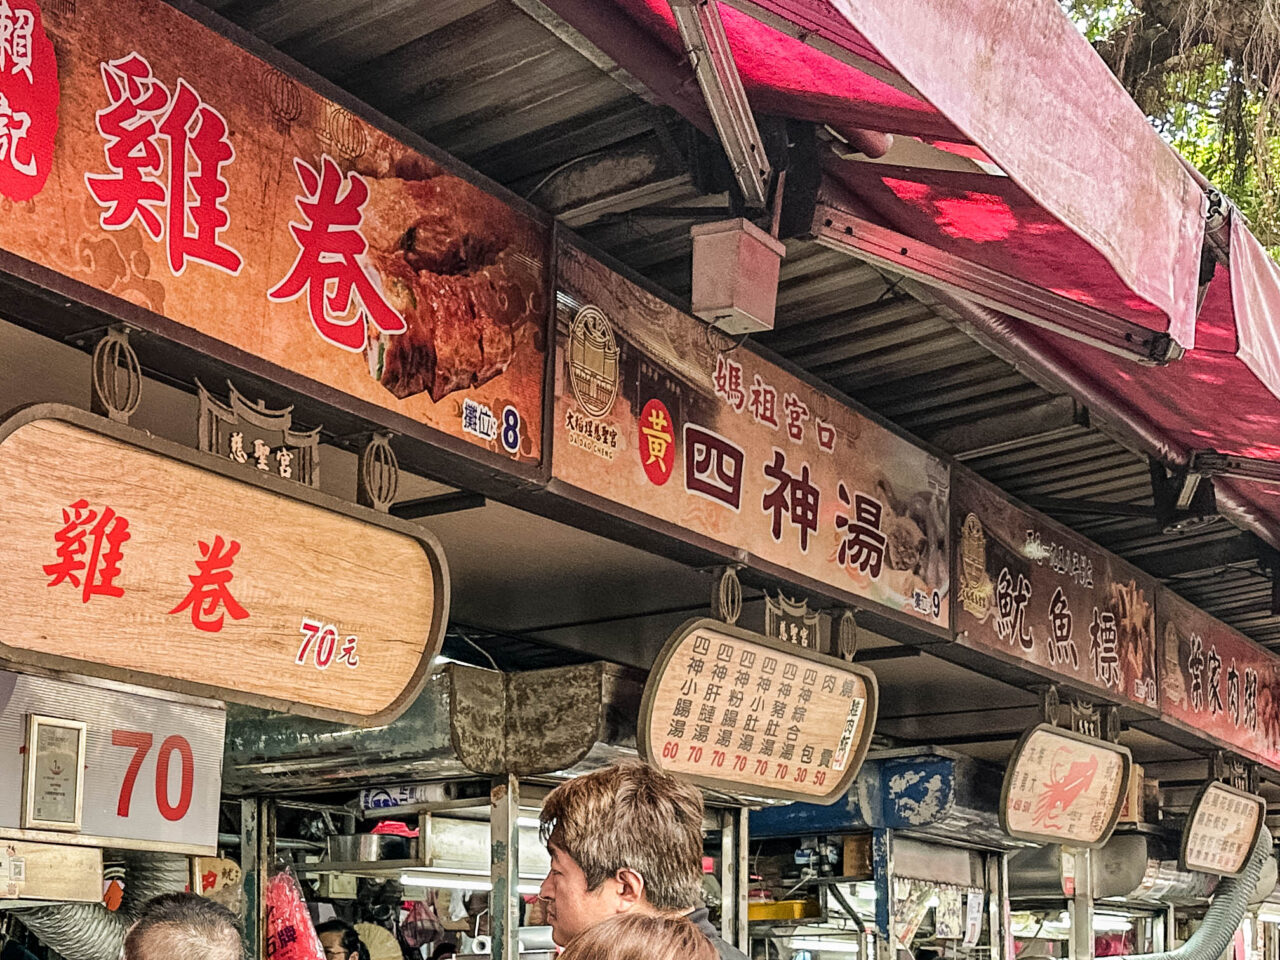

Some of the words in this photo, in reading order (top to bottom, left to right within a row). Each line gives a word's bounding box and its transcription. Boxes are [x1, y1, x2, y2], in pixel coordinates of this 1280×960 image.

[85, 52, 407, 352] 雞卷
[713, 355, 837, 453] 媽祖宮口
[502, 407, 520, 452] 8
[642, 409, 672, 473] 黃
[228, 431, 295, 479] 慈聖宮
[683, 422, 887, 579] 四神湯
[42, 499, 250, 633] 雞卷
[295, 616, 360, 670] 70元
[666, 636, 711, 739] 四神小腸湯
[662, 742, 678, 759] 60
[686, 746, 703, 763] 70
[710, 750, 725, 767] 70
[732, 754, 747, 771] 70
[753, 759, 768, 776] 70
[774, 763, 788, 780] 70
[111, 729, 195, 823] 70
[793, 767, 808, 783] 30
[813, 770, 826, 786] 50
